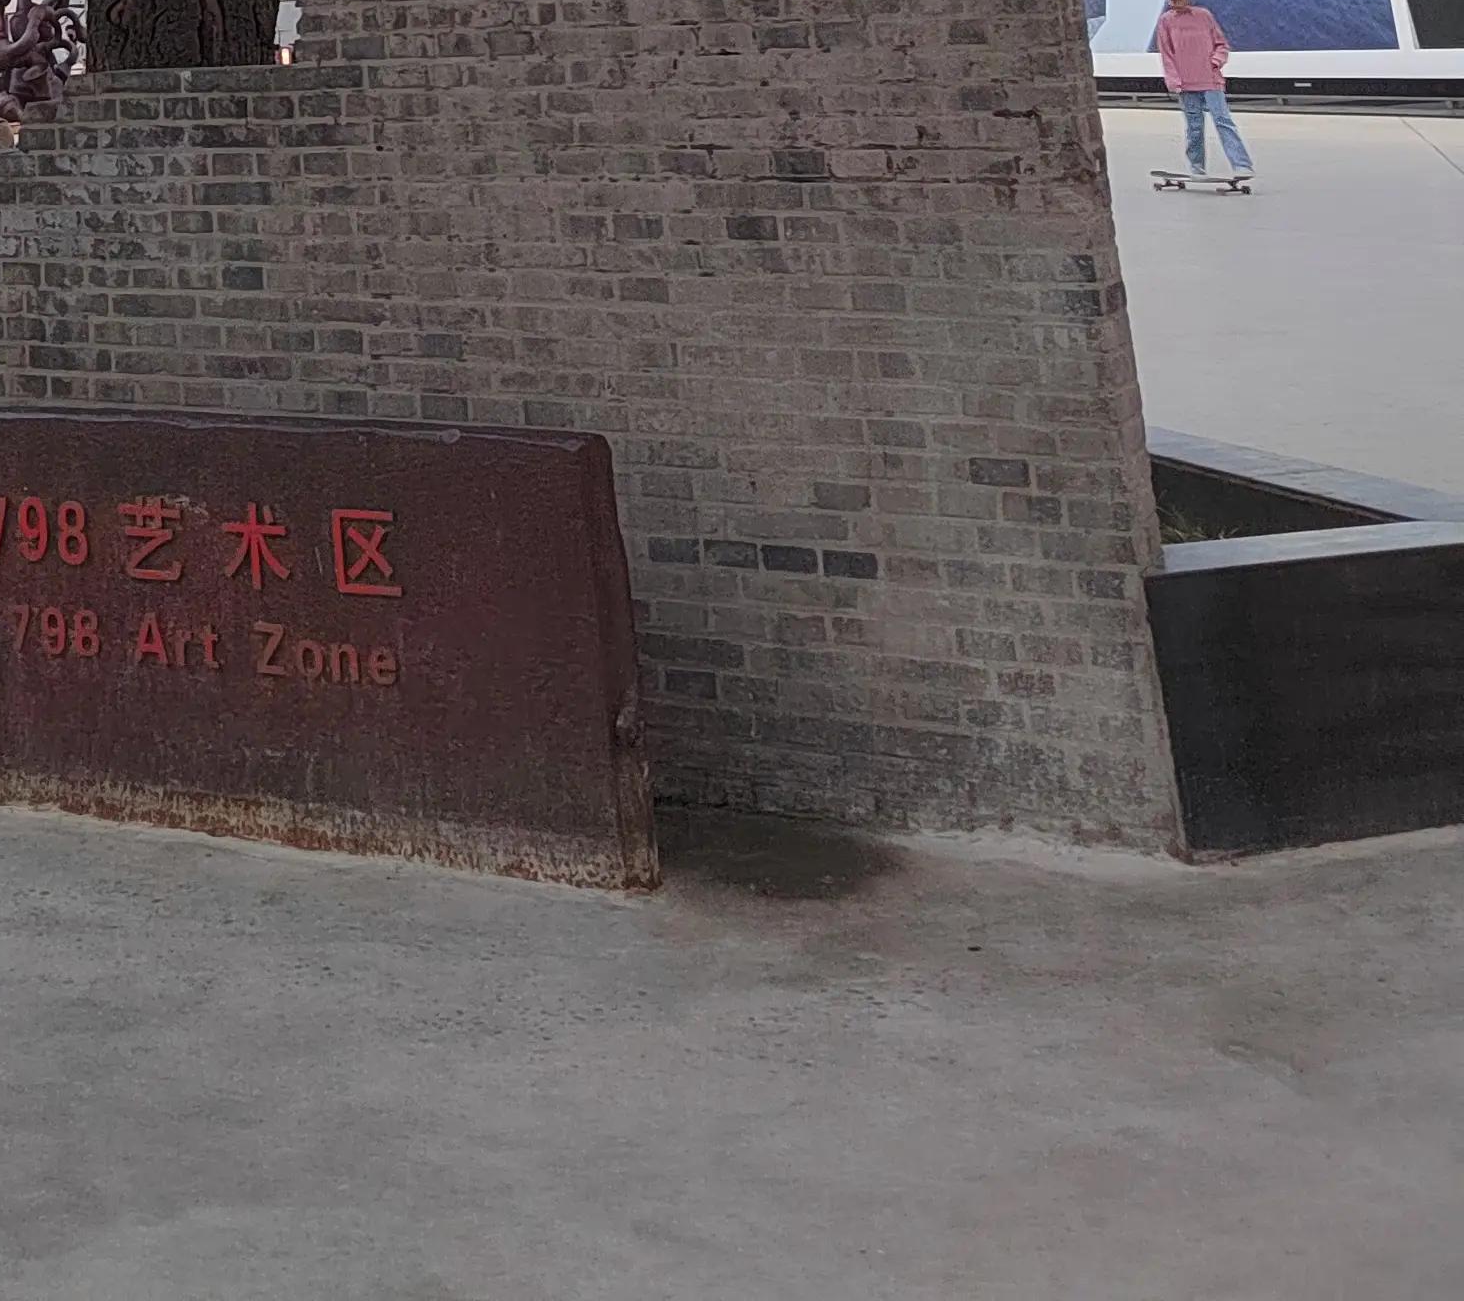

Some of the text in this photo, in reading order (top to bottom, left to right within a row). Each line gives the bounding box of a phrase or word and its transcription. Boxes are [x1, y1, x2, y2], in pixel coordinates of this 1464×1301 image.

[10, 603, 101, 658] 798
[136, 612, 220, 669] Art
[252, 619, 398, 685] Zone
